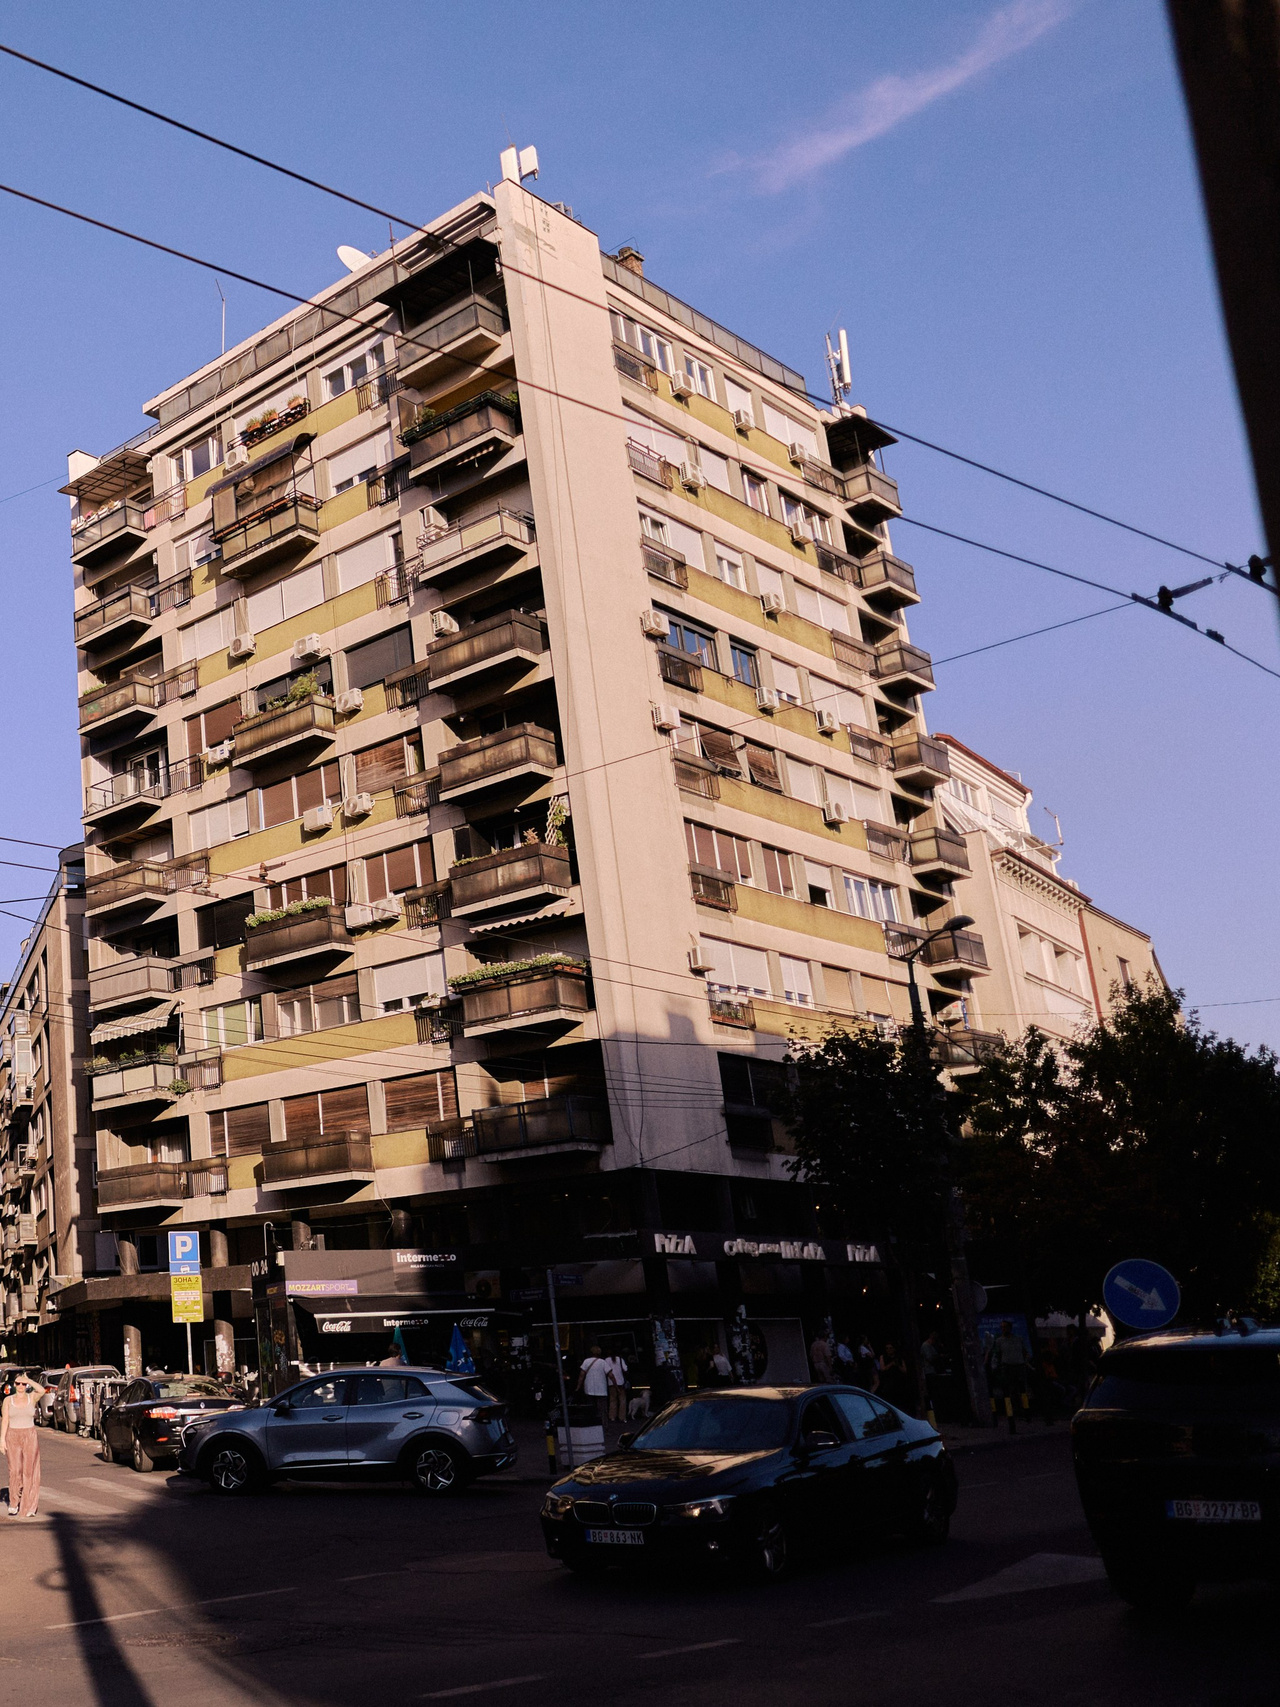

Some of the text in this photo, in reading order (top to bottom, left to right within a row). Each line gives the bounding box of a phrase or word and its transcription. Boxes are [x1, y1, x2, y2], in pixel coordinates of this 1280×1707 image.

[175, 1236, 192, 1259] P
[1175, 1502, 1192, 1517] BG
[592, 1531, 603, 1542] BG
